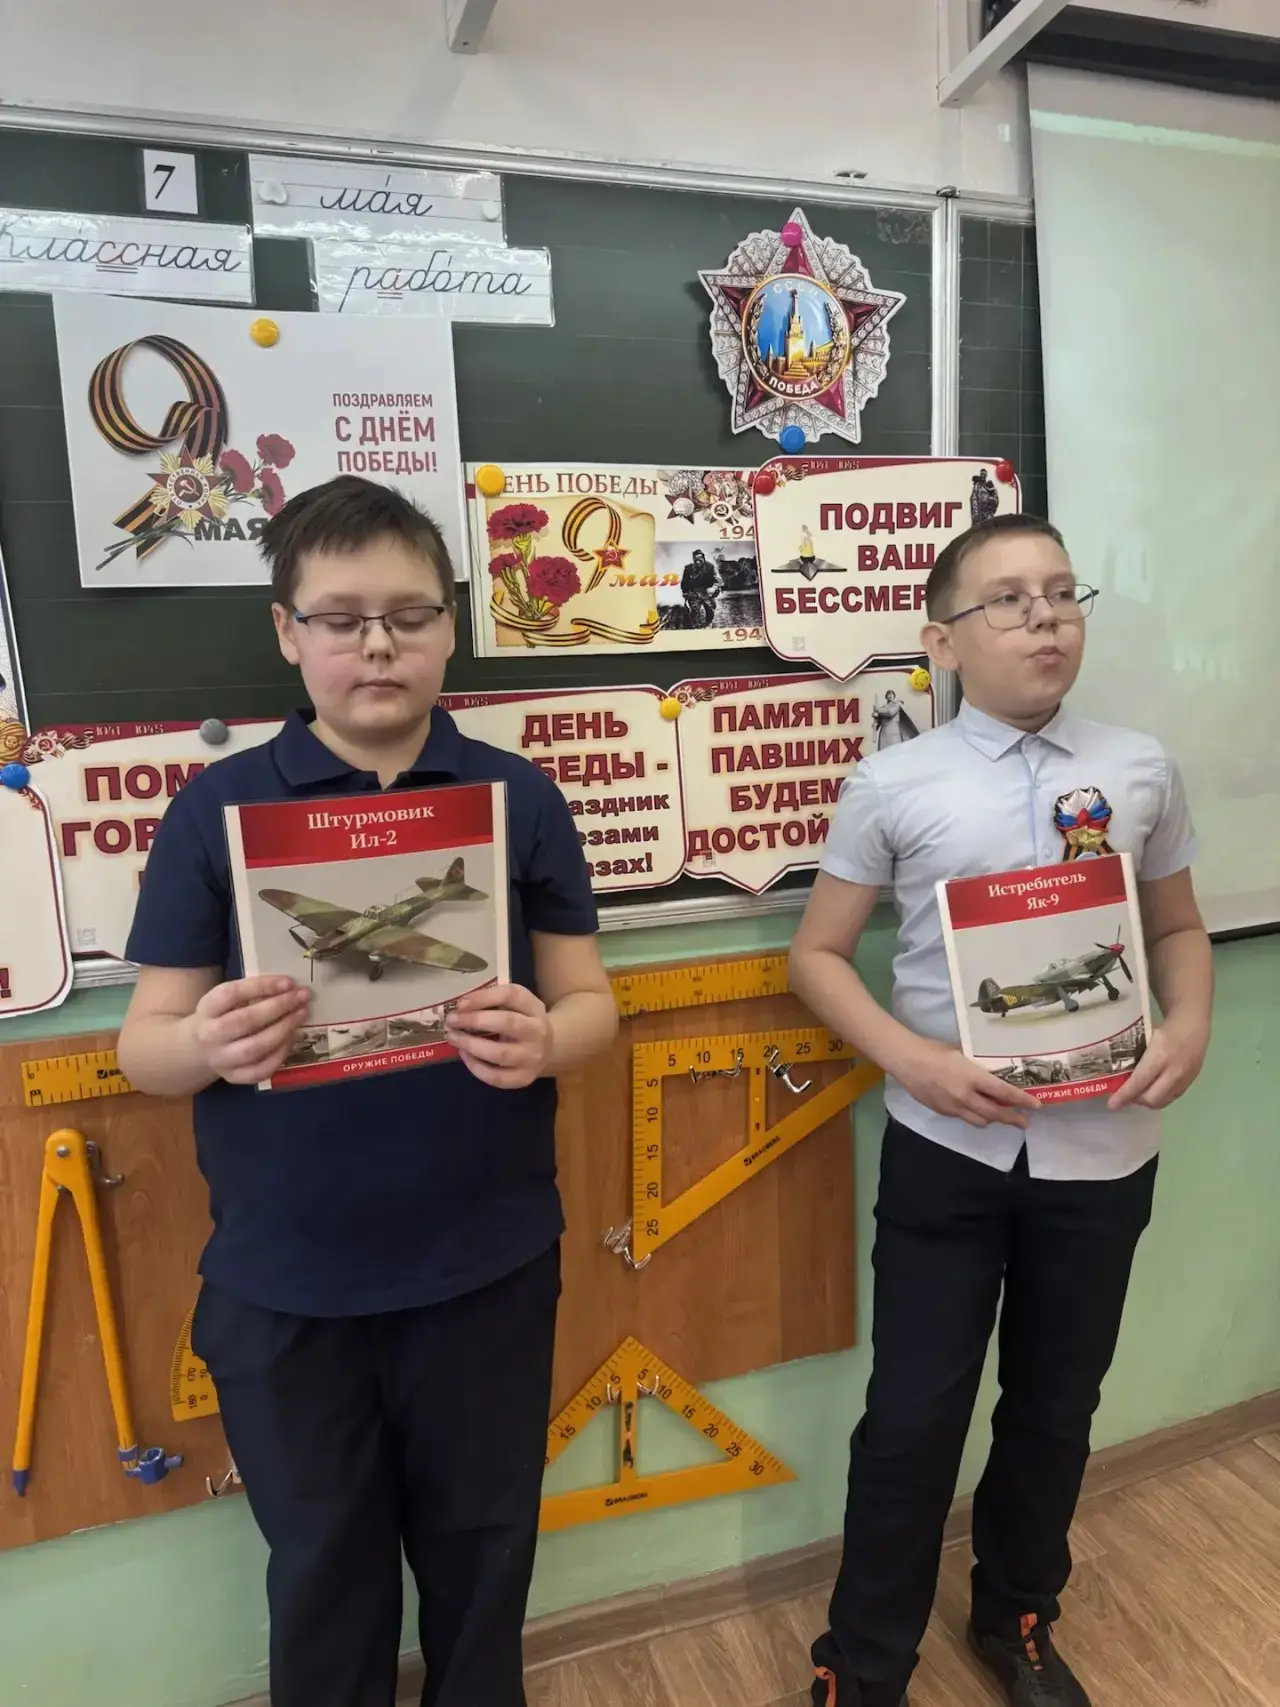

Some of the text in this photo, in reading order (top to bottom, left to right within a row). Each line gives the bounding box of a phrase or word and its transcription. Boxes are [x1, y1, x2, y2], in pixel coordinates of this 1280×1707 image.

[152, 164, 176, 200] 7
[768, 375, 819, 396] ПОБЕДА
[333, 393, 433, 409] ПОЗДРАВЛЯЕМ
[335, 410, 435, 446] С ДНЁМ
[337, 450, 438, 475] ПОБЕДЫ!
[503, 472, 659, 498] ЕНЬ ПОБЕДЫ
[194, 517, 270, 541] МАЯ
[820, 501, 963, 535] ПОДВИГ
[719, 525, 755, 540] 194
[857, 543, 935, 572] ВАШ
[609, 573, 680, 588] мая
[775, 584, 928, 615] БЕССМЕР
[722, 628, 762, 643] 194
[713, 698, 860, 733] ПАМЯТИ
[521, 711, 628, 748] ДЕНЬ
[711, 737, 864, 774] ПАВШИХ
[84, 763, 205, 801] ПОМ
[531, 751, 645, 787] БЕДЫ
[568, 794, 670, 817] аздник
[730, 777, 846, 813] БУДЕМ
[307, 806, 435, 830] Штурмовик
[61, 818, 162, 856] ГОР
[350, 830, 397, 849] Ил-2
[577, 826, 659, 846] езами
[686, 813, 830, 863] ДОСТОЙ
[587, 852, 653, 877] азах!
[988, 873, 1086, 897] Истребитель
[1027, 893, 1060, 910] Як-9
[343, 1049, 434, 1072] ОРУЖИЕ ПОБЕДЫ
[668, 1054, 676, 1067] 5
[697, 1051, 711, 1064] 10
[797, 1042, 811, 1054] 25
[829, 1040, 843, 1051] 30
[1036, 1083, 1108, 1099] ОРУЖИЕ ПОБЕДЫ
[647, 1078, 658, 1236] 5 10 15 20 25
[560, 1375, 621, 1439] 15 10 5
[637, 1368, 764, 1475] 5 10 15 20 25 30
